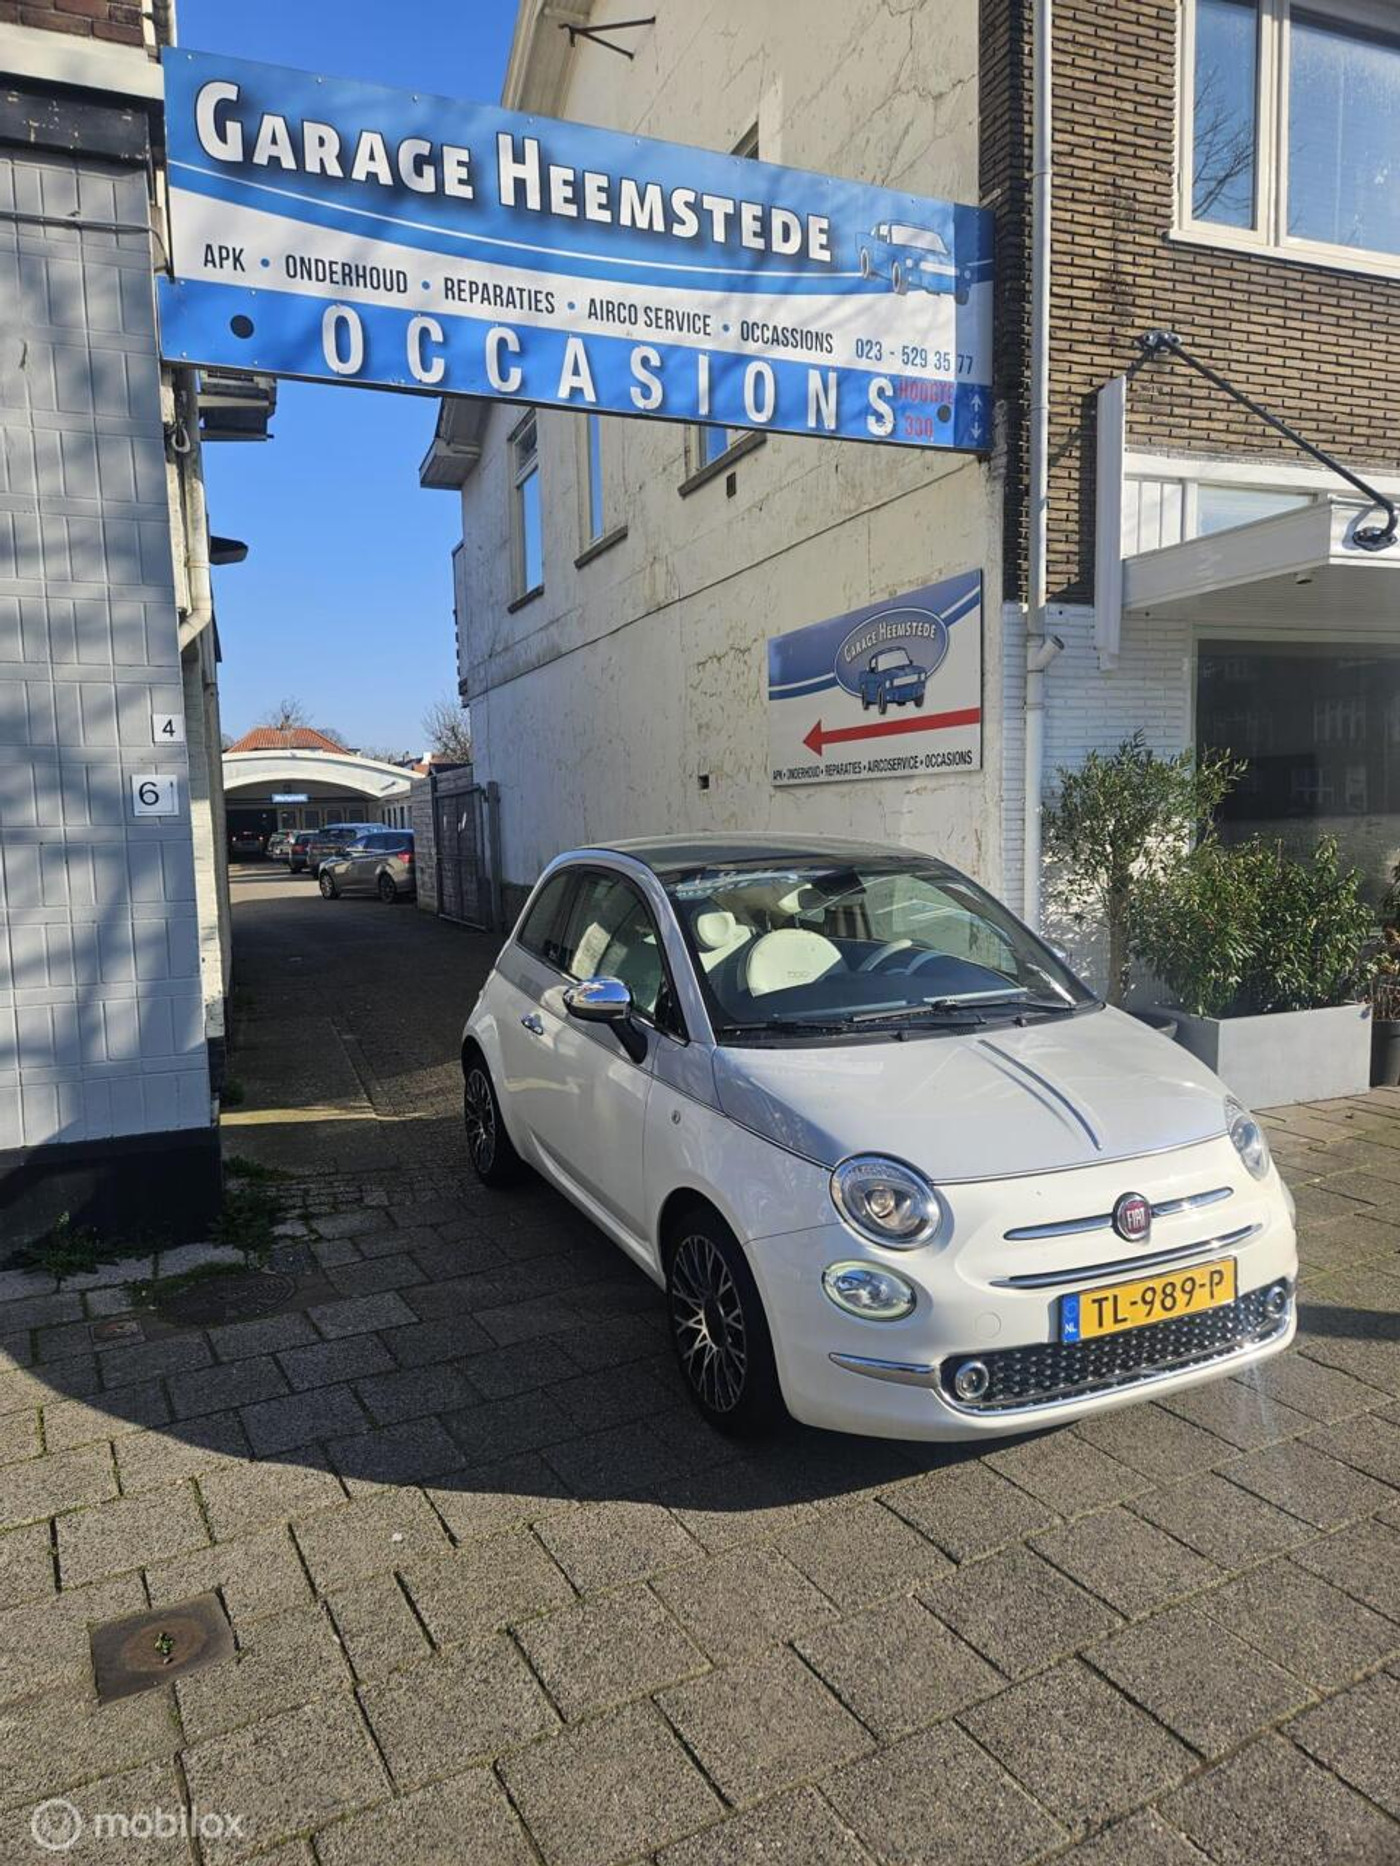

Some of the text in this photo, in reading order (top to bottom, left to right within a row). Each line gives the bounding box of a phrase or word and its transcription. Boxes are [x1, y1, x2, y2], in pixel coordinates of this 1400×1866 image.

[195, 80, 832, 263] GARAGE HEEMSTEDE
[203, 243, 246, 273] APK
[285, 254, 409, 295] ONDERHOUD
[444, 277, 556, 315] REPARATIES
[587, 298, 639, 326] AIRCO
[644, 306, 712, 337] SERVICE
[740, 320, 835, 355] OCCASSIONS
[855, 338, 882, 361] 023
[901, 346, 927, 367] 529
[934, 350, 951, 371] 35
[956, 354, 974, 375] 77
[321, 304, 894, 436] OCCASIONS
[844, 621, 937, 662] GARAGE HEEMSTEDE
[162, 718, 176, 737] 4
[825, 761, 862, 776] REPARATIES
[924, 749, 973, 769] OCCASIONS
[139, 781, 160, 807] 6
[1126, 1208, 1145, 1229] FIAT
[1064, 1269, 1225, 1334] NL TL-989-P
